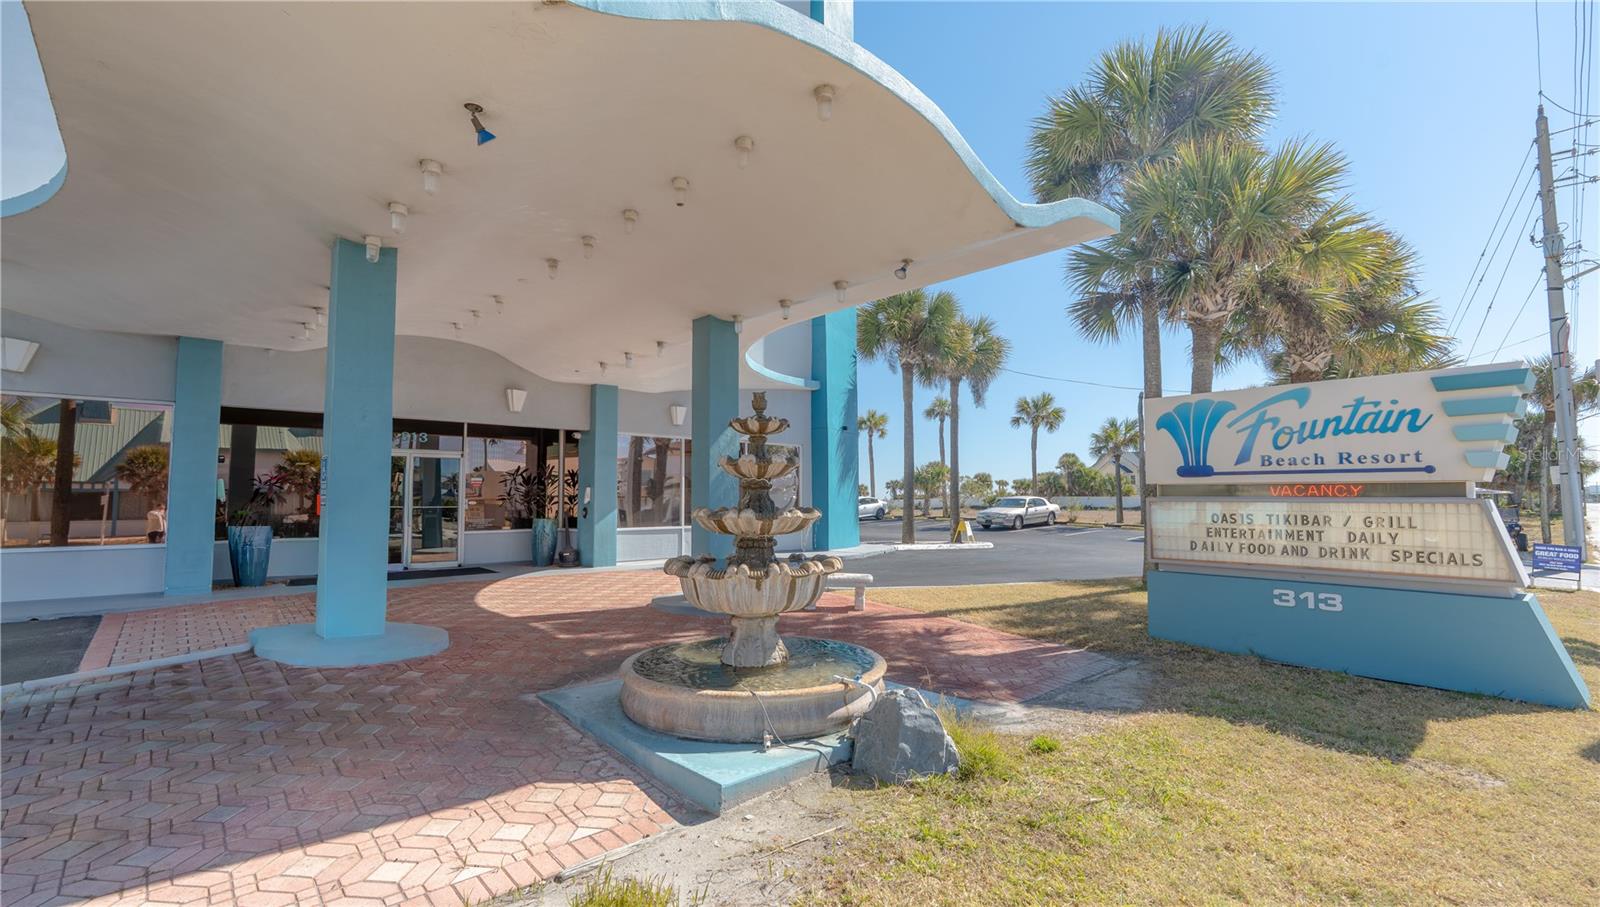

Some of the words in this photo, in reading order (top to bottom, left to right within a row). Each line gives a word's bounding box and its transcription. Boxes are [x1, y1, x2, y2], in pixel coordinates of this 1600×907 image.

[1226, 387, 1433, 466] Fountain
[1260, 453, 1325, 467] Beach
[1338, 450, 1422, 465] Resort
[1269, 484, 1364, 497] VACANCY
[1211, 513, 1254, 525] OASIS
[1266, 513, 1332, 527] TIKIBAR
[1343, 516, 1352, 527] /
[1363, 515, 1417, 529] GRILL
[1206, 527, 1325, 542] ENTERTAINMENT
[1348, 531, 1399, 545] DAILY
[1190, 540, 1234, 553] DAILY
[1240, 543, 1276, 556] FOOD
[1281, 545, 1309, 557] AND
[1319, 546, 1370, 559] DRINK
[1391, 550, 1484, 567] SPECIALS
[1273, 588, 1343, 612] 313
